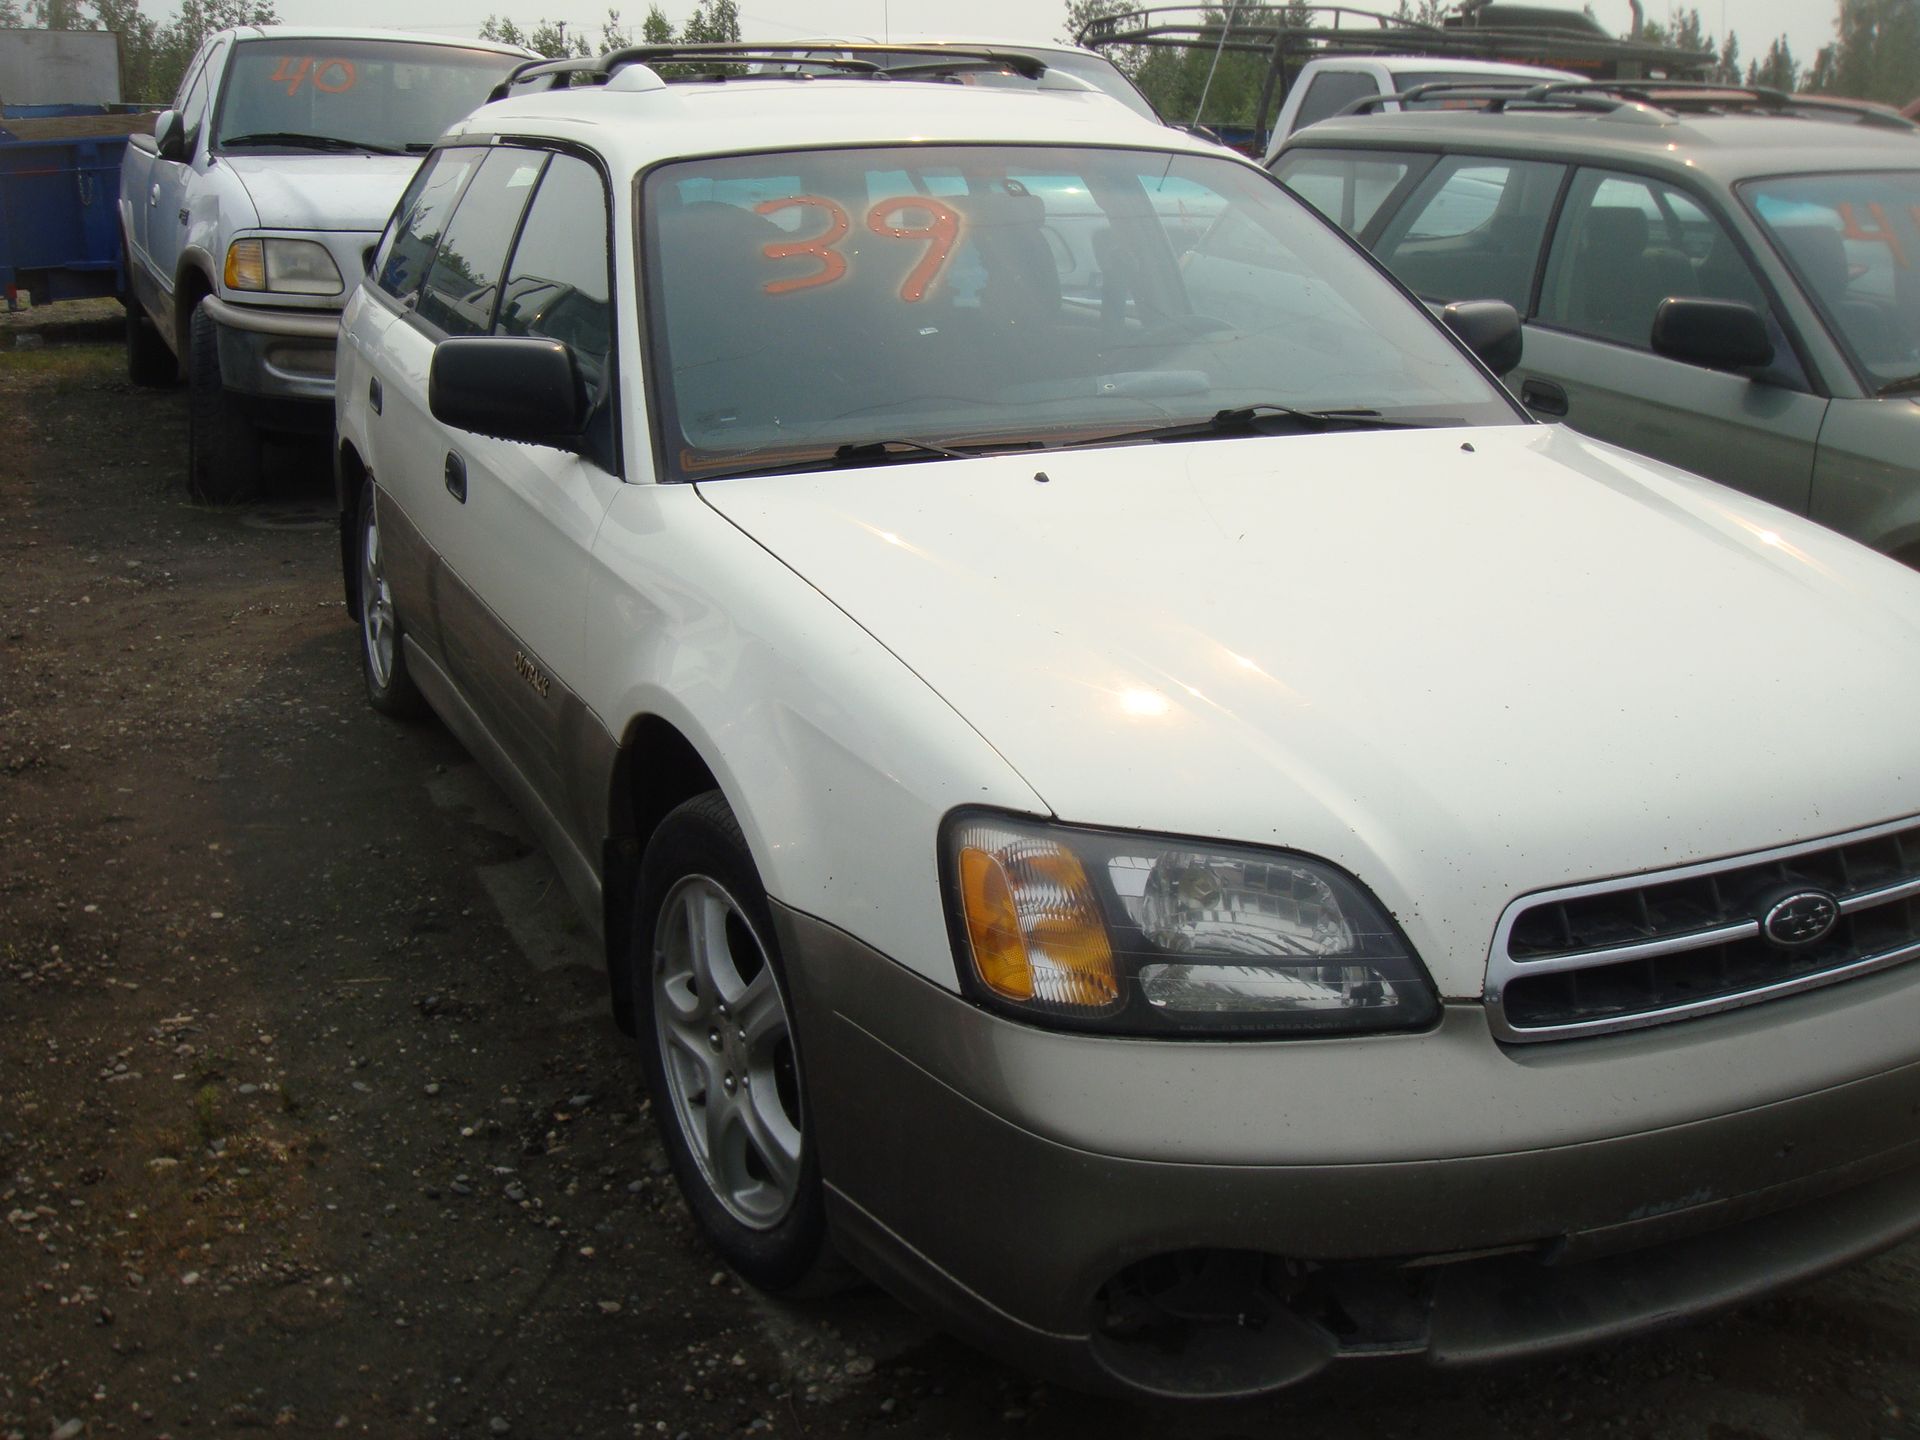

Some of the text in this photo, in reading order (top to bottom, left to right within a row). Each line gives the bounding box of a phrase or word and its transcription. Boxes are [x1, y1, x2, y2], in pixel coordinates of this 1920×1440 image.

[271, 54, 357, 97] 40
[754, 194, 964, 303] 39
[1838, 201, 1920, 270] 4
